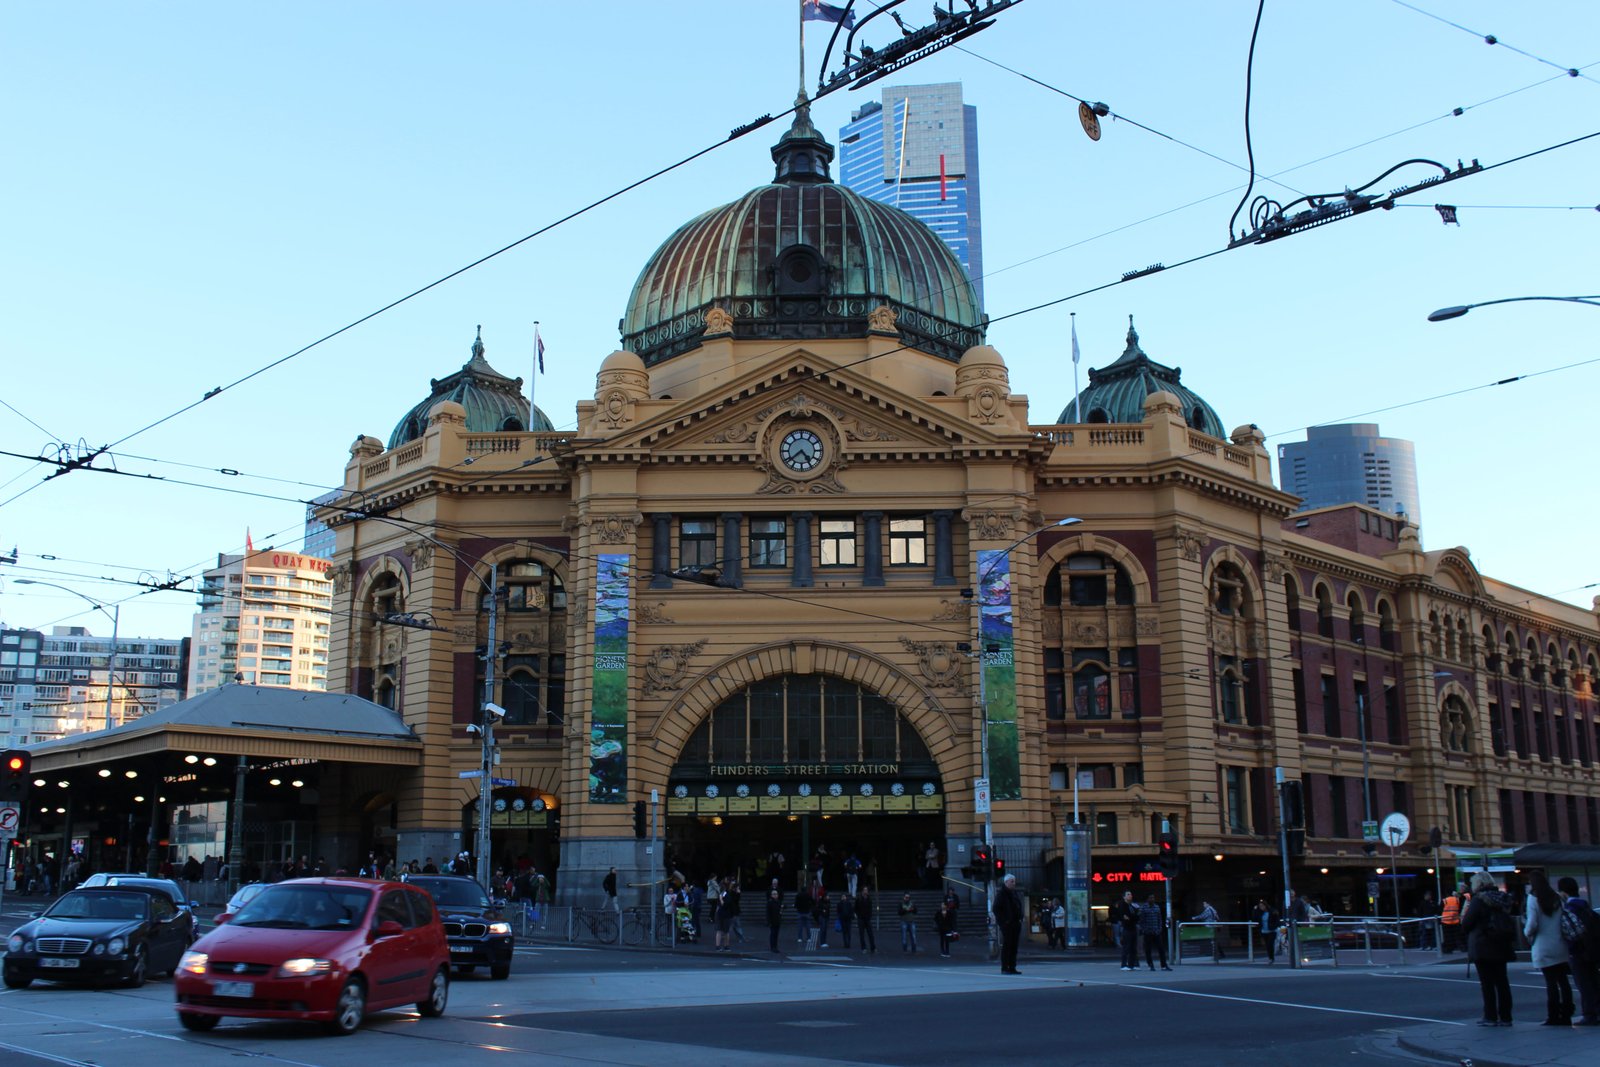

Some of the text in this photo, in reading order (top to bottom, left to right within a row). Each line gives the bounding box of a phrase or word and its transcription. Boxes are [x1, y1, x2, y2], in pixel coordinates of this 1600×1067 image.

[274, 554, 302, 568] QUAY
[710, 764, 899, 776] FLINDERS STREET STATION
[1106, 872, 1168, 882] CITY HATTE
